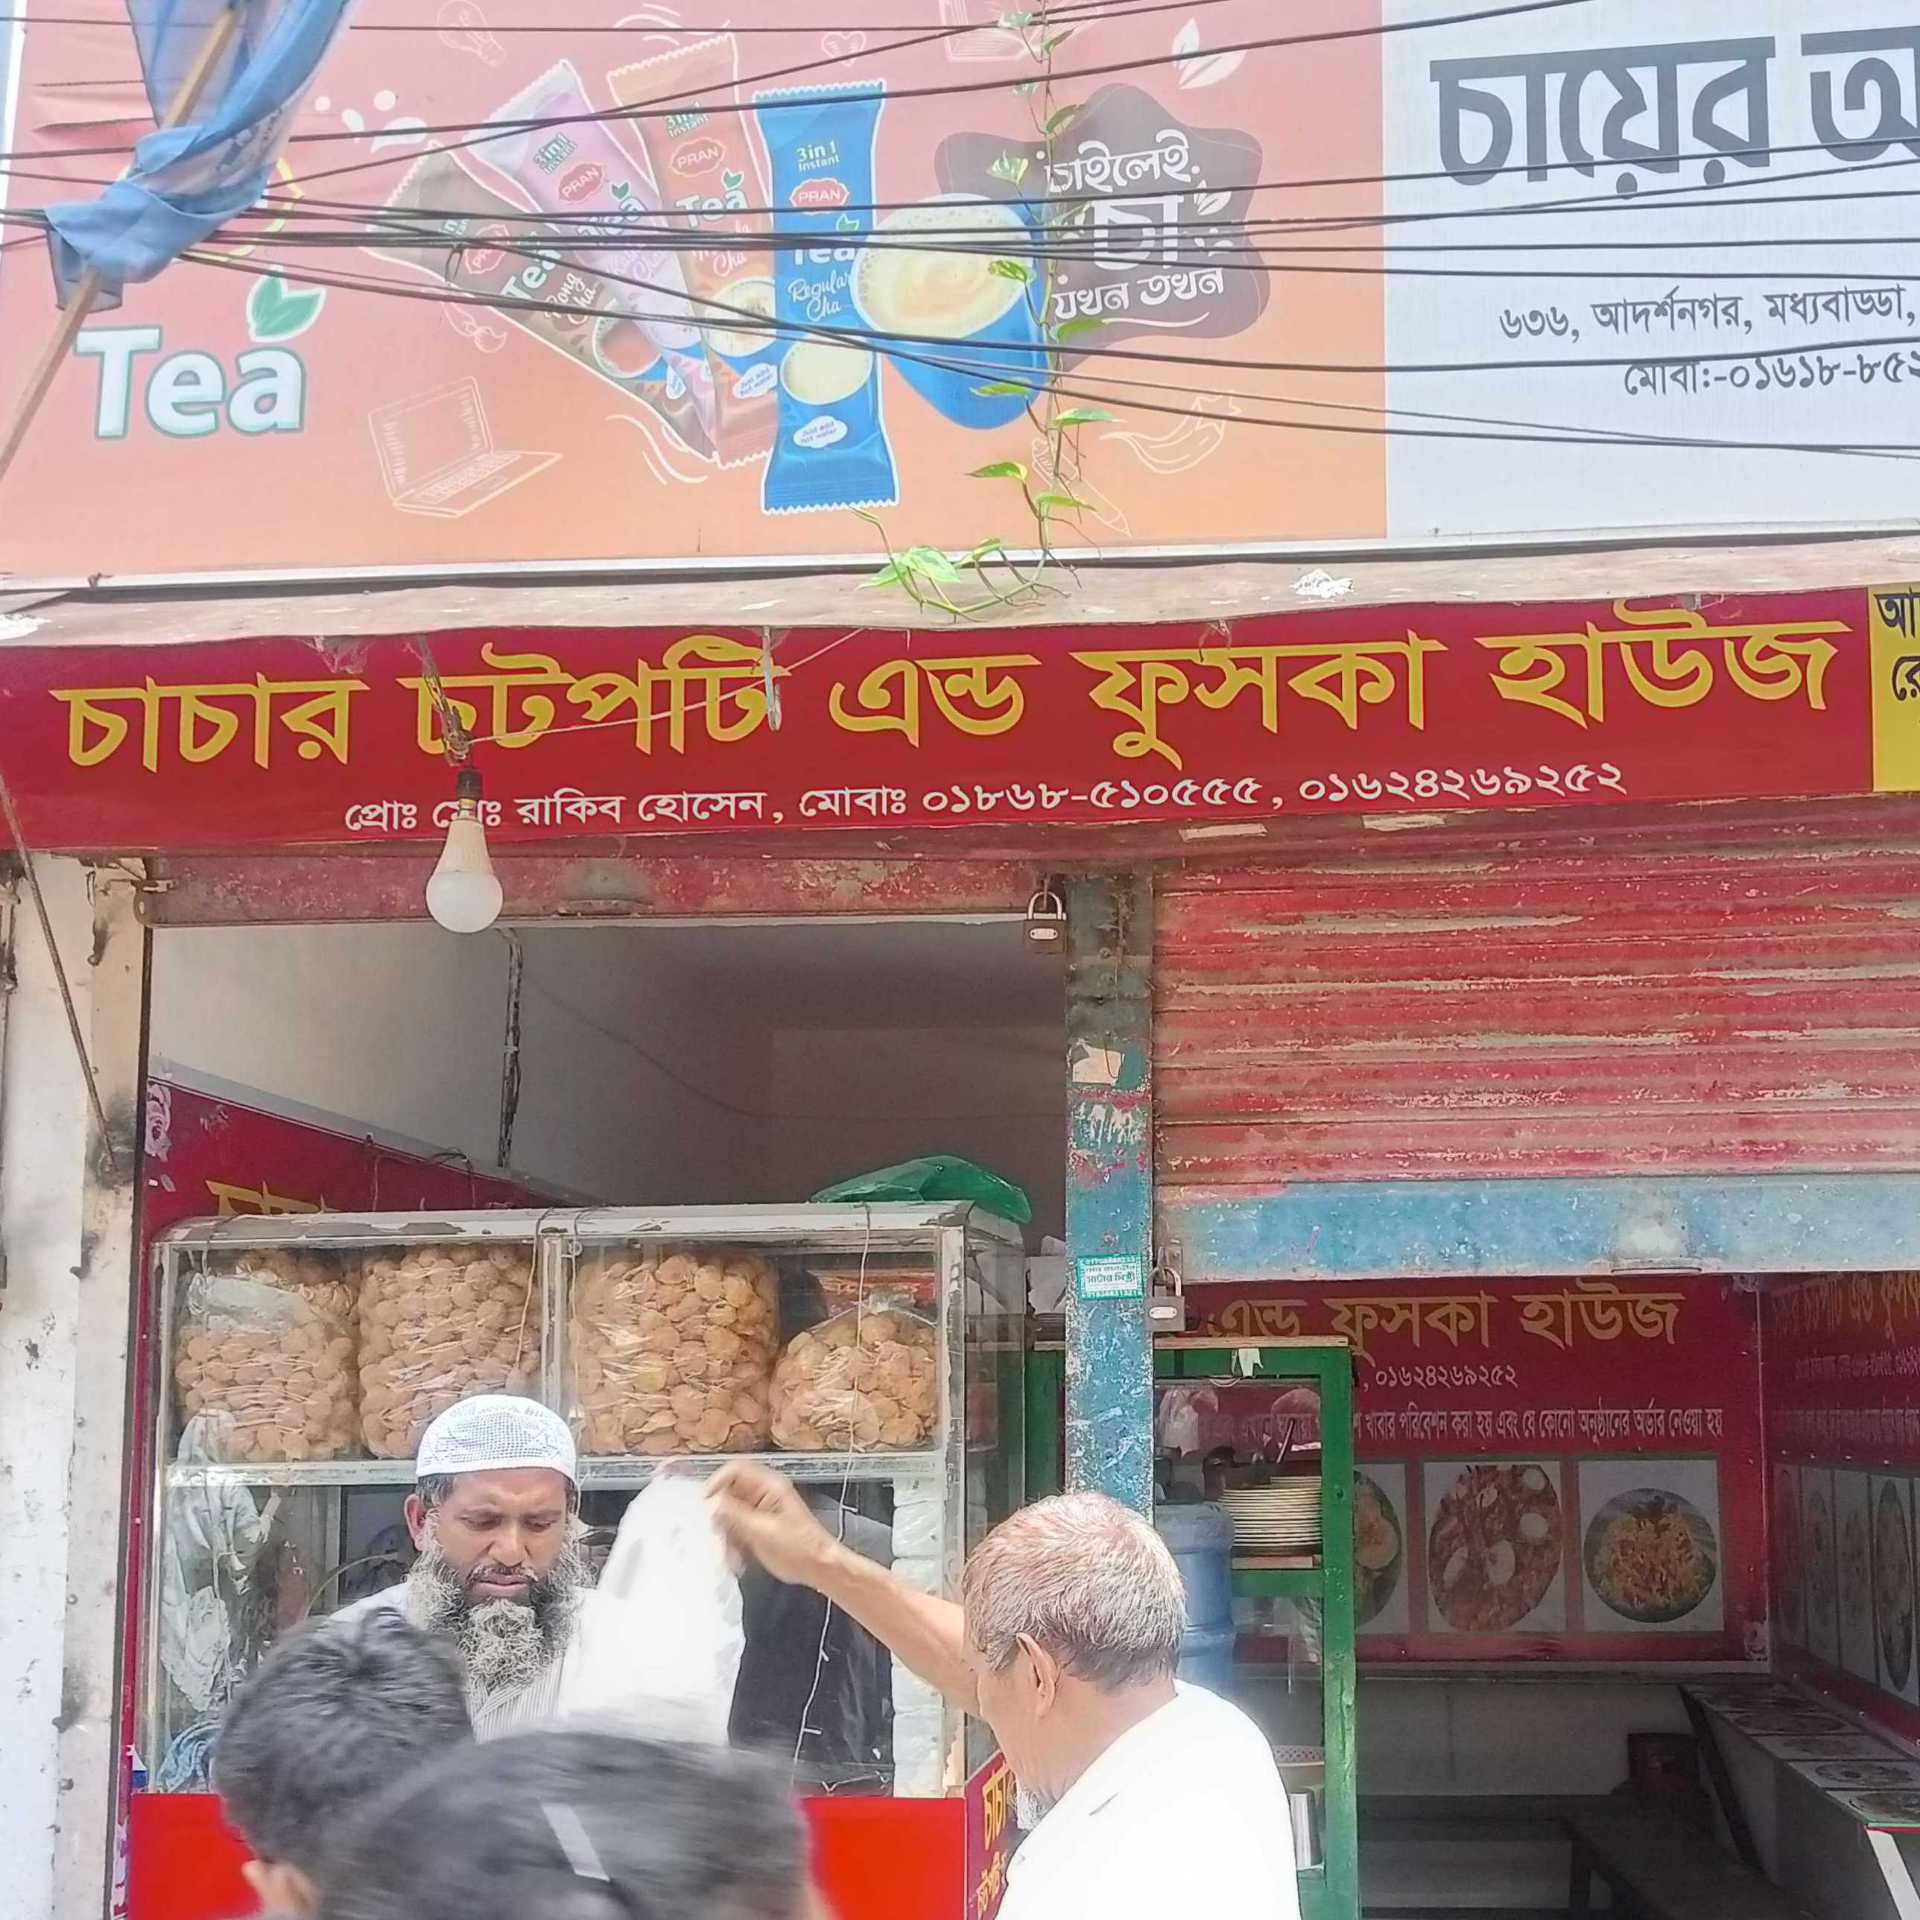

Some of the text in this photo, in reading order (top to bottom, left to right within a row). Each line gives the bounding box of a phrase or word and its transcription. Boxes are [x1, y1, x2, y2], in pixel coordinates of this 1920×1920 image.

[1429, 36, 1776, 200] চায়ের
[562, 167, 600, 199] PRAN
[678, 147, 720, 169] PRAN
[1044, 129, 1192, 193] চাইলেই
[676, 189, 750, 229] Tea
[799, 189, 841, 202] PRAN
[1089, 195, 1185, 270] চা
[787, 269, 851, 303] Regular
[806, 295, 841, 322] Cha
[1051, 267, 1226, 320] যখন তখন
[1499, 283, 1917, 342] ৬৩৬, আদর্শনগর, মধ্যবাড্ডা,
[75, 325, 308, 440] Tea
[49, 599, 1854, 773] চাচার চটপটি এন্ড ফুসকা হাউজ
[345, 800, 417, 832] প্রোঃ
[515, 786, 627, 827] রাকিব
[800, 784, 906, 818] মোবাঃ
[1300, 762, 1628, 804] ০১৬২৪২৬৯২৫২
[1323, 1292, 1498, 1368] ফুসকা
[1512, 1277, 1685, 1350] হাউজ
[1375, 1364, 1519, 1389] ০১৬২৪২৬৯২৫২
[1495, 1410, 1520, 1439] এবং
[1538, 1408, 1575, 1439] কোনো
